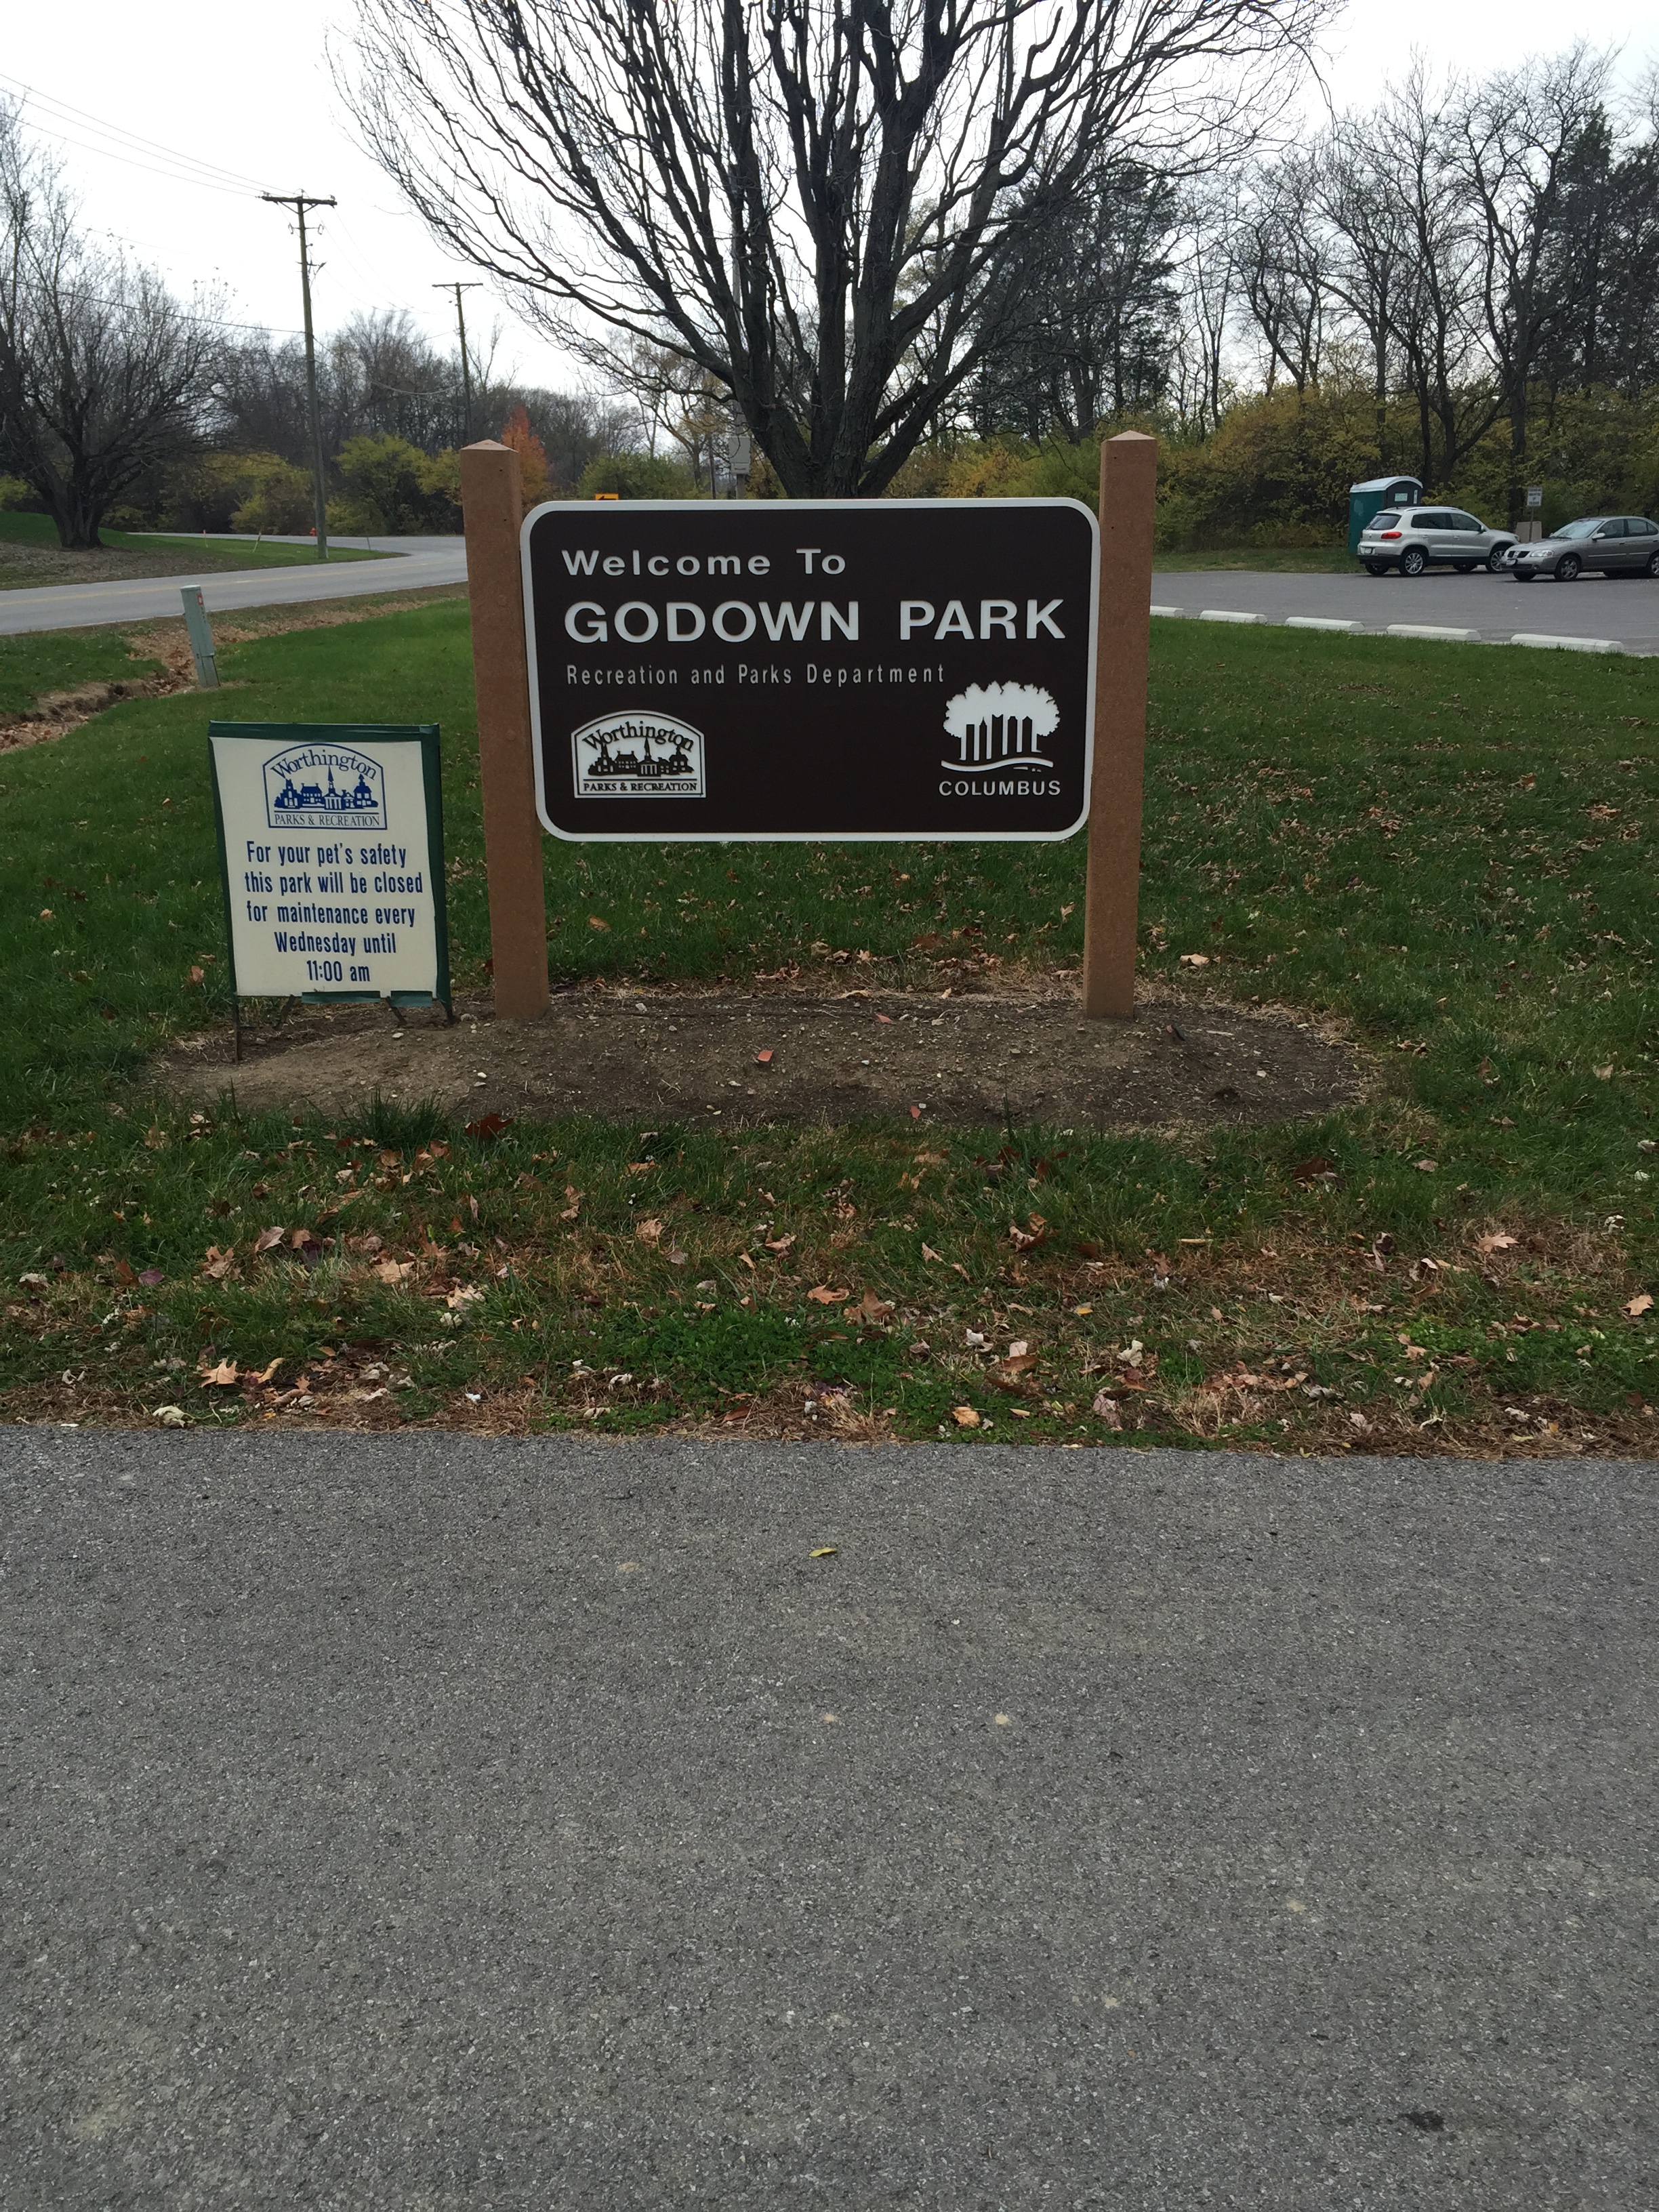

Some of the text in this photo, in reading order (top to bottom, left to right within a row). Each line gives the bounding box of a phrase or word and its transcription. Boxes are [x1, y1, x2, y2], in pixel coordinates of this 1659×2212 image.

[562, 548, 846, 576] Welcome To
[564, 598, 1066, 643] GODOWN PARK
[567, 663, 945, 687] Recreation and Parks Department
[582, 720, 694, 752] Worthington
[270, 749, 377, 780] Worthington
[583, 782, 697, 792] PARKS & RECREATION
[939, 780, 1061, 796] COLUMBUS
[274, 814, 380, 827] PARKS & RECREATION
[247, 841, 407, 868] For your pet's safety
[245, 872, 423, 896] this park will be closed
[247, 901, 415, 927] for maintenance every
[274, 932, 396, 956] Wednesday until
[306, 960, 371, 982] 11:00 am
